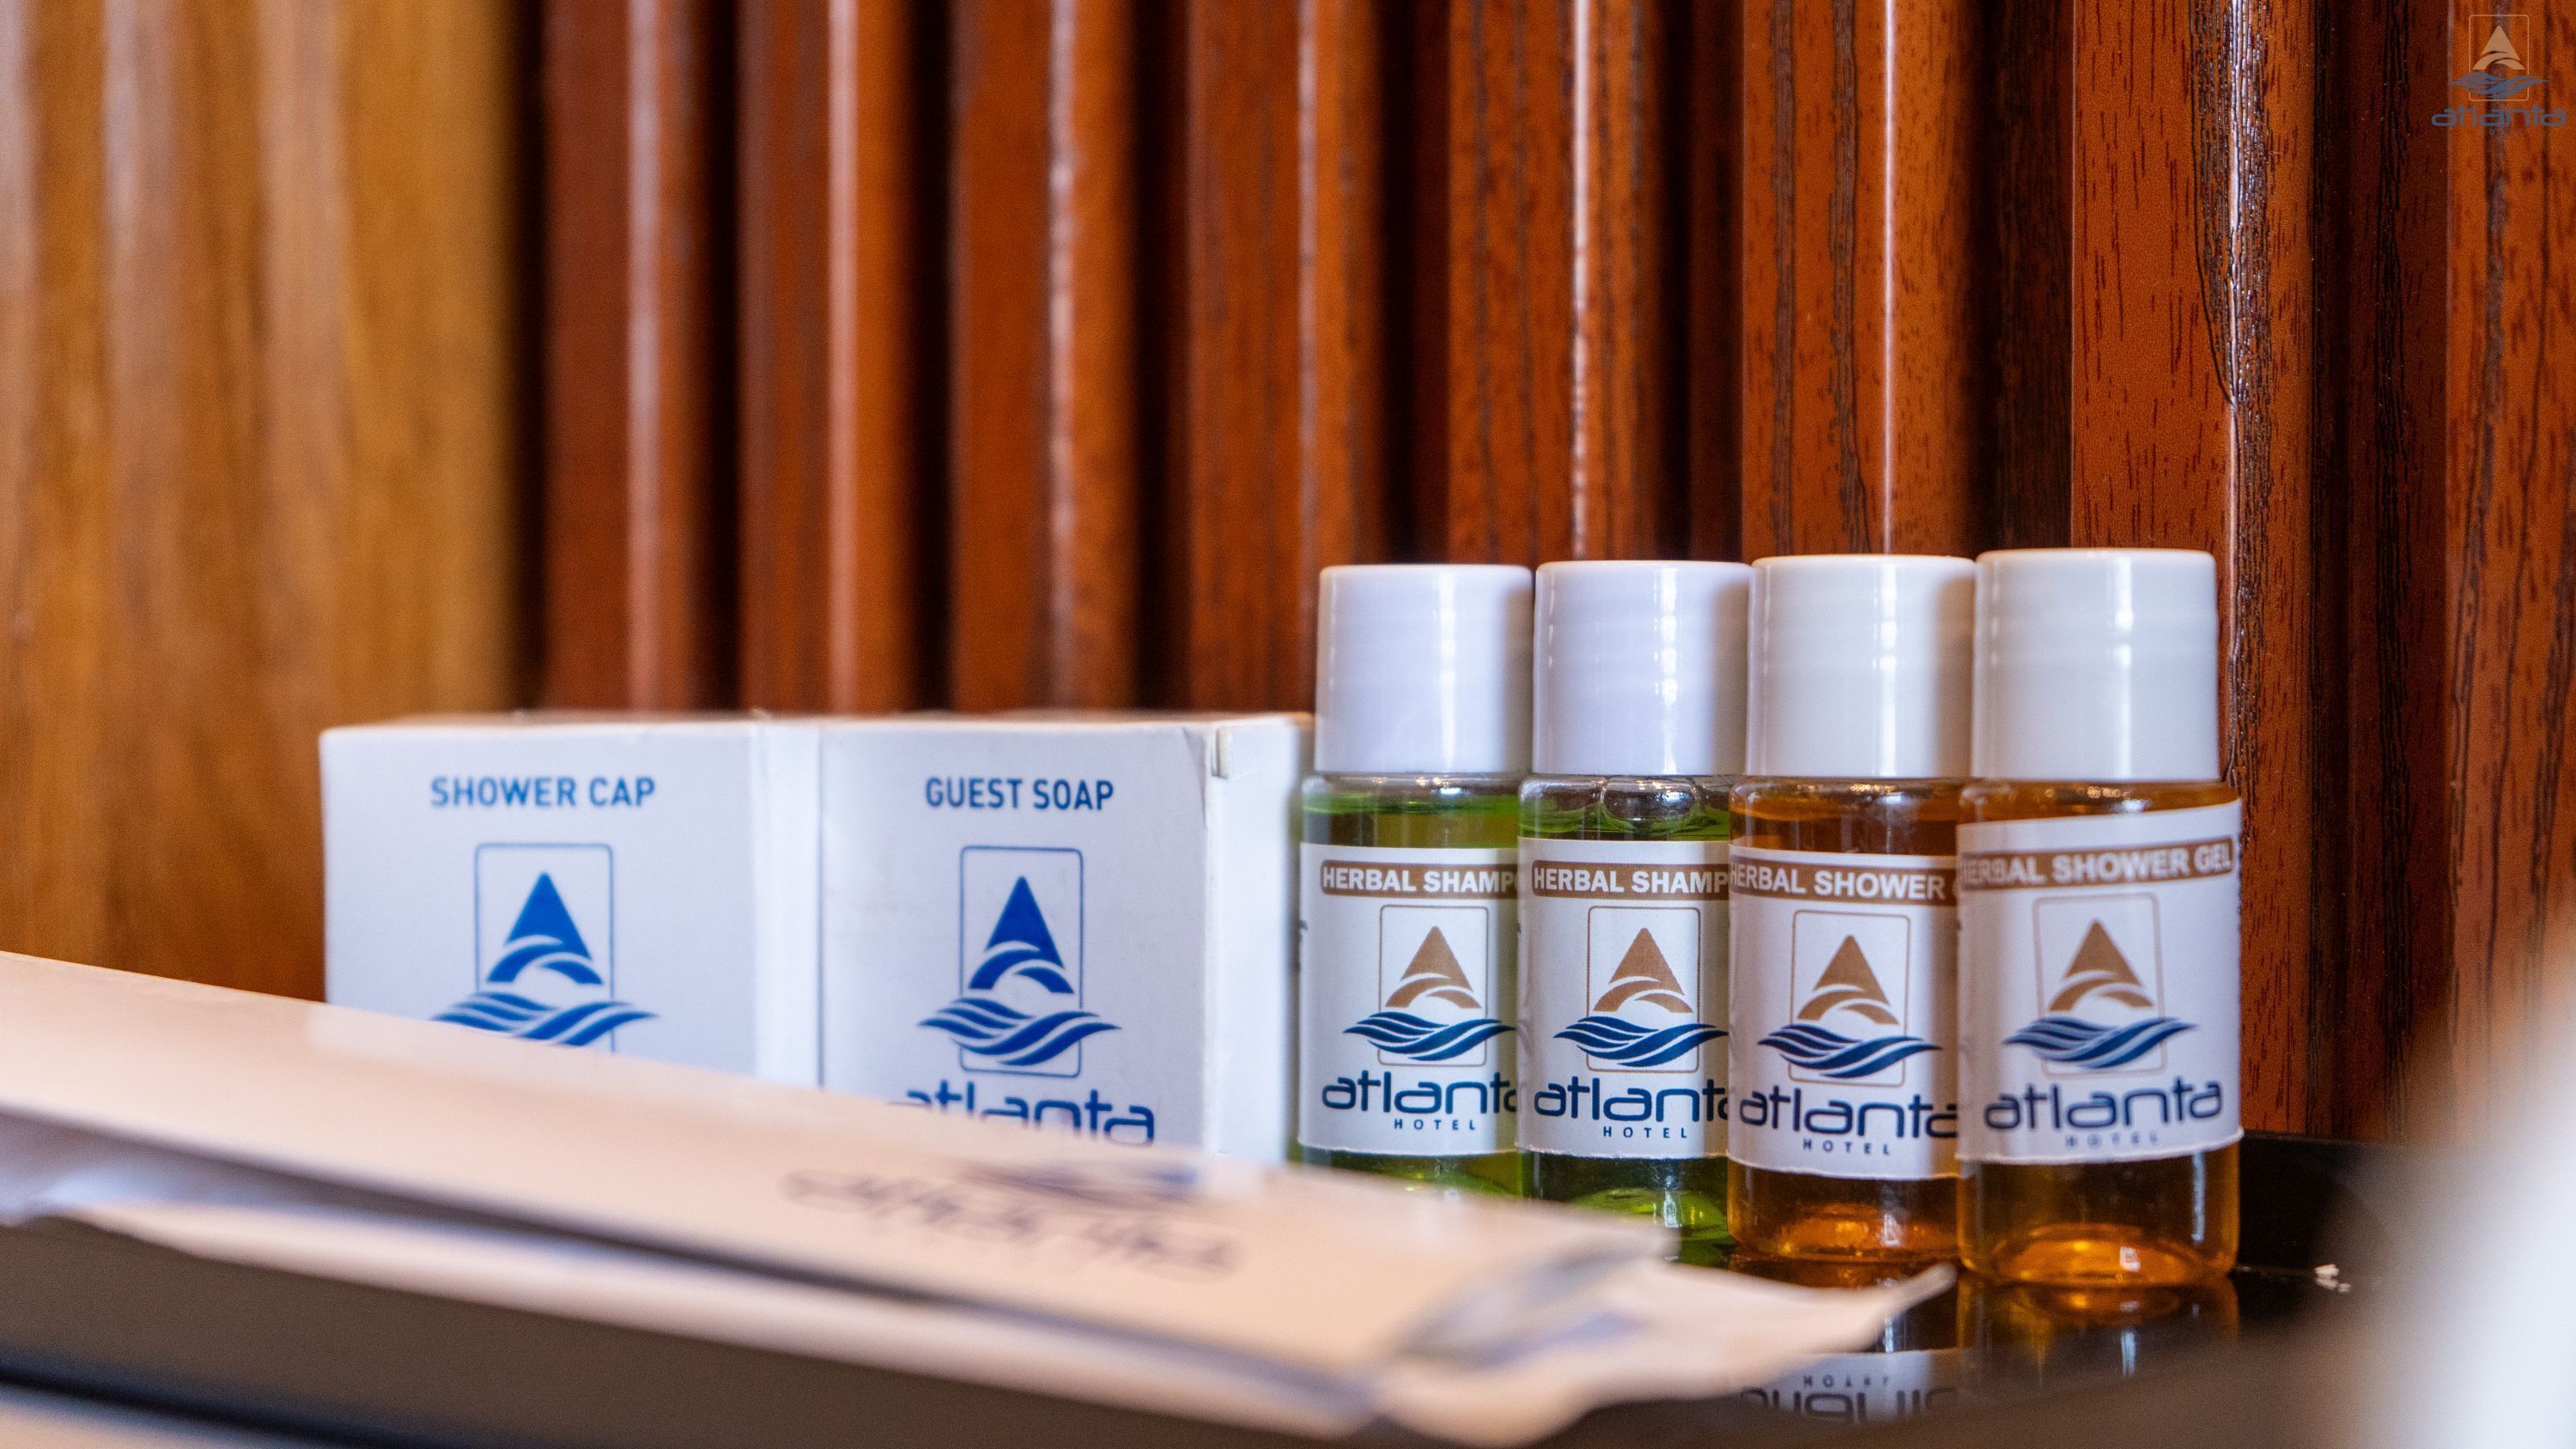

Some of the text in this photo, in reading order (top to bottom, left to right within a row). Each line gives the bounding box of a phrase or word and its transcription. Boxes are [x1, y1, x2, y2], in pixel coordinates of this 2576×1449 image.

[430, 776, 656, 808] SHOWER CAP
[926, 777, 1114, 810] GUEST SOAP
[2051, 846, 2190, 885] SHOWER
[2193, 842, 2232, 874] GEL
[1322, 865, 1517, 894] HERBAL SHAMP
[1533, 866, 1625, 894] HERBAL
[1730, 861, 1807, 894] HERBAL
[1814, 870, 1944, 900] SHOWER
[1984, 1075, 2223, 1131] atlanta
[1394, 1118, 1475, 1131] HOTEL
[1603, 1126, 1687, 1139] HOTEL
[1802, 1139, 1891, 1155] HOTEL
